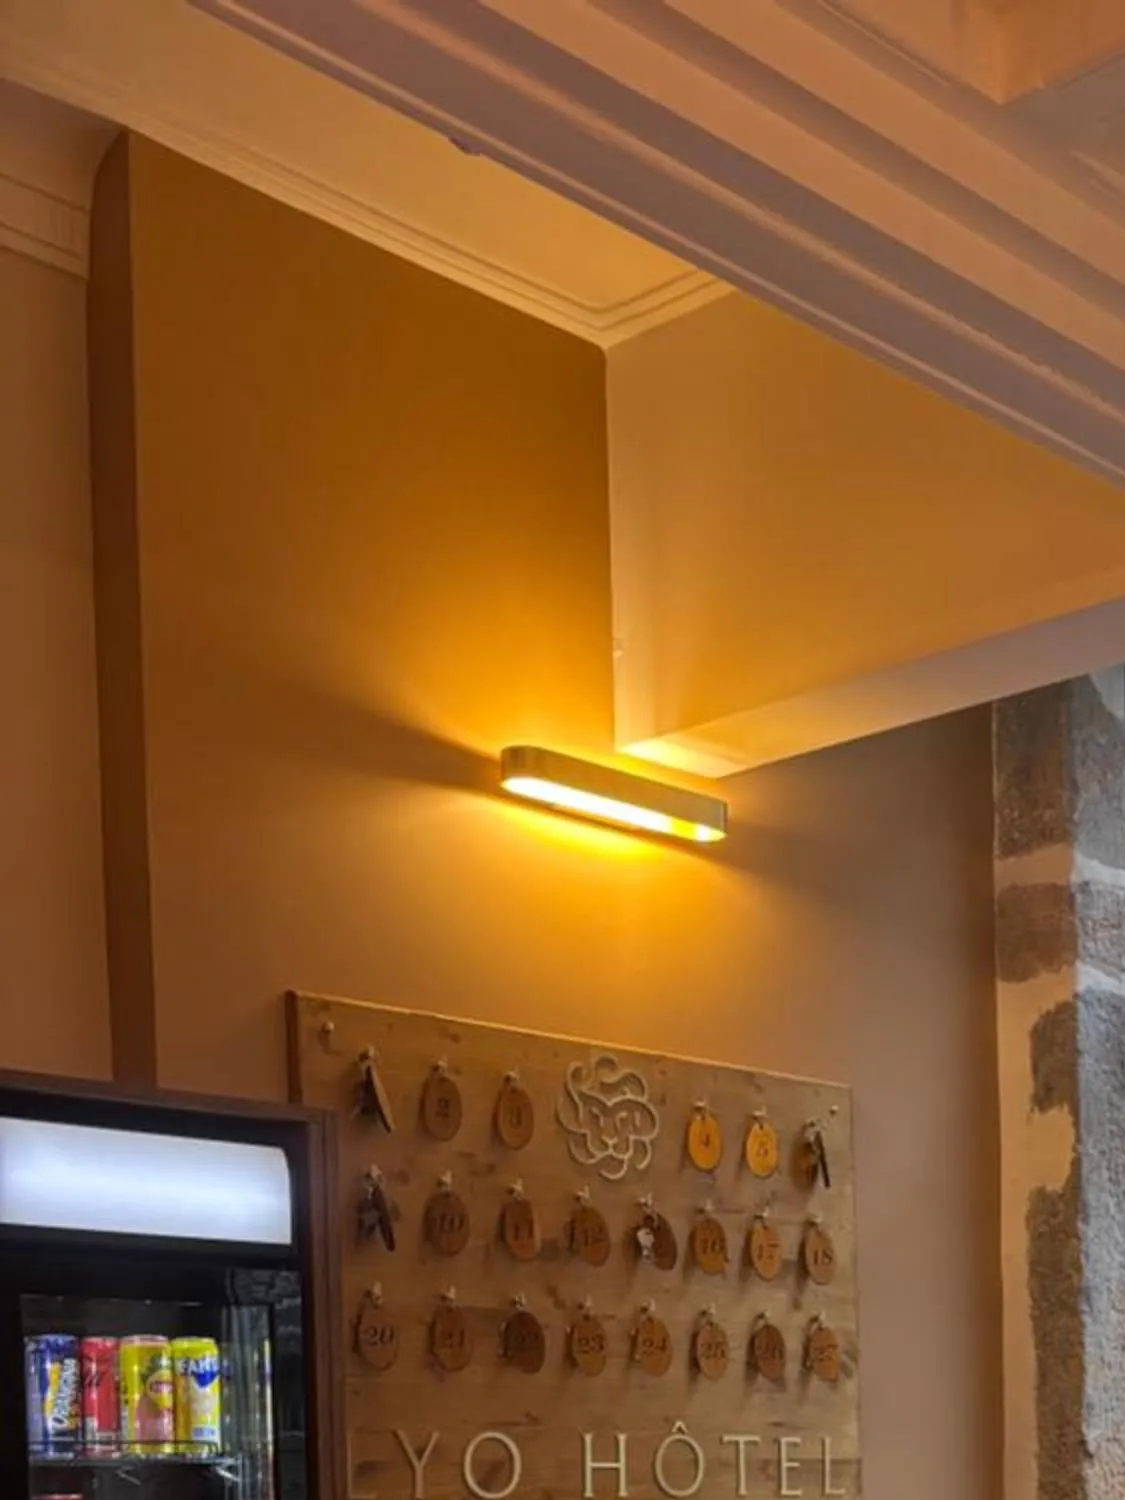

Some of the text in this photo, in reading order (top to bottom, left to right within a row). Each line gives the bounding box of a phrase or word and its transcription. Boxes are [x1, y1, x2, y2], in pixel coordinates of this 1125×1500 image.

[813, 1248, 833, 1266] 18
[365, 1325, 395, 1346] 20
[582, 1420, 847, 1498] HÔTEL
